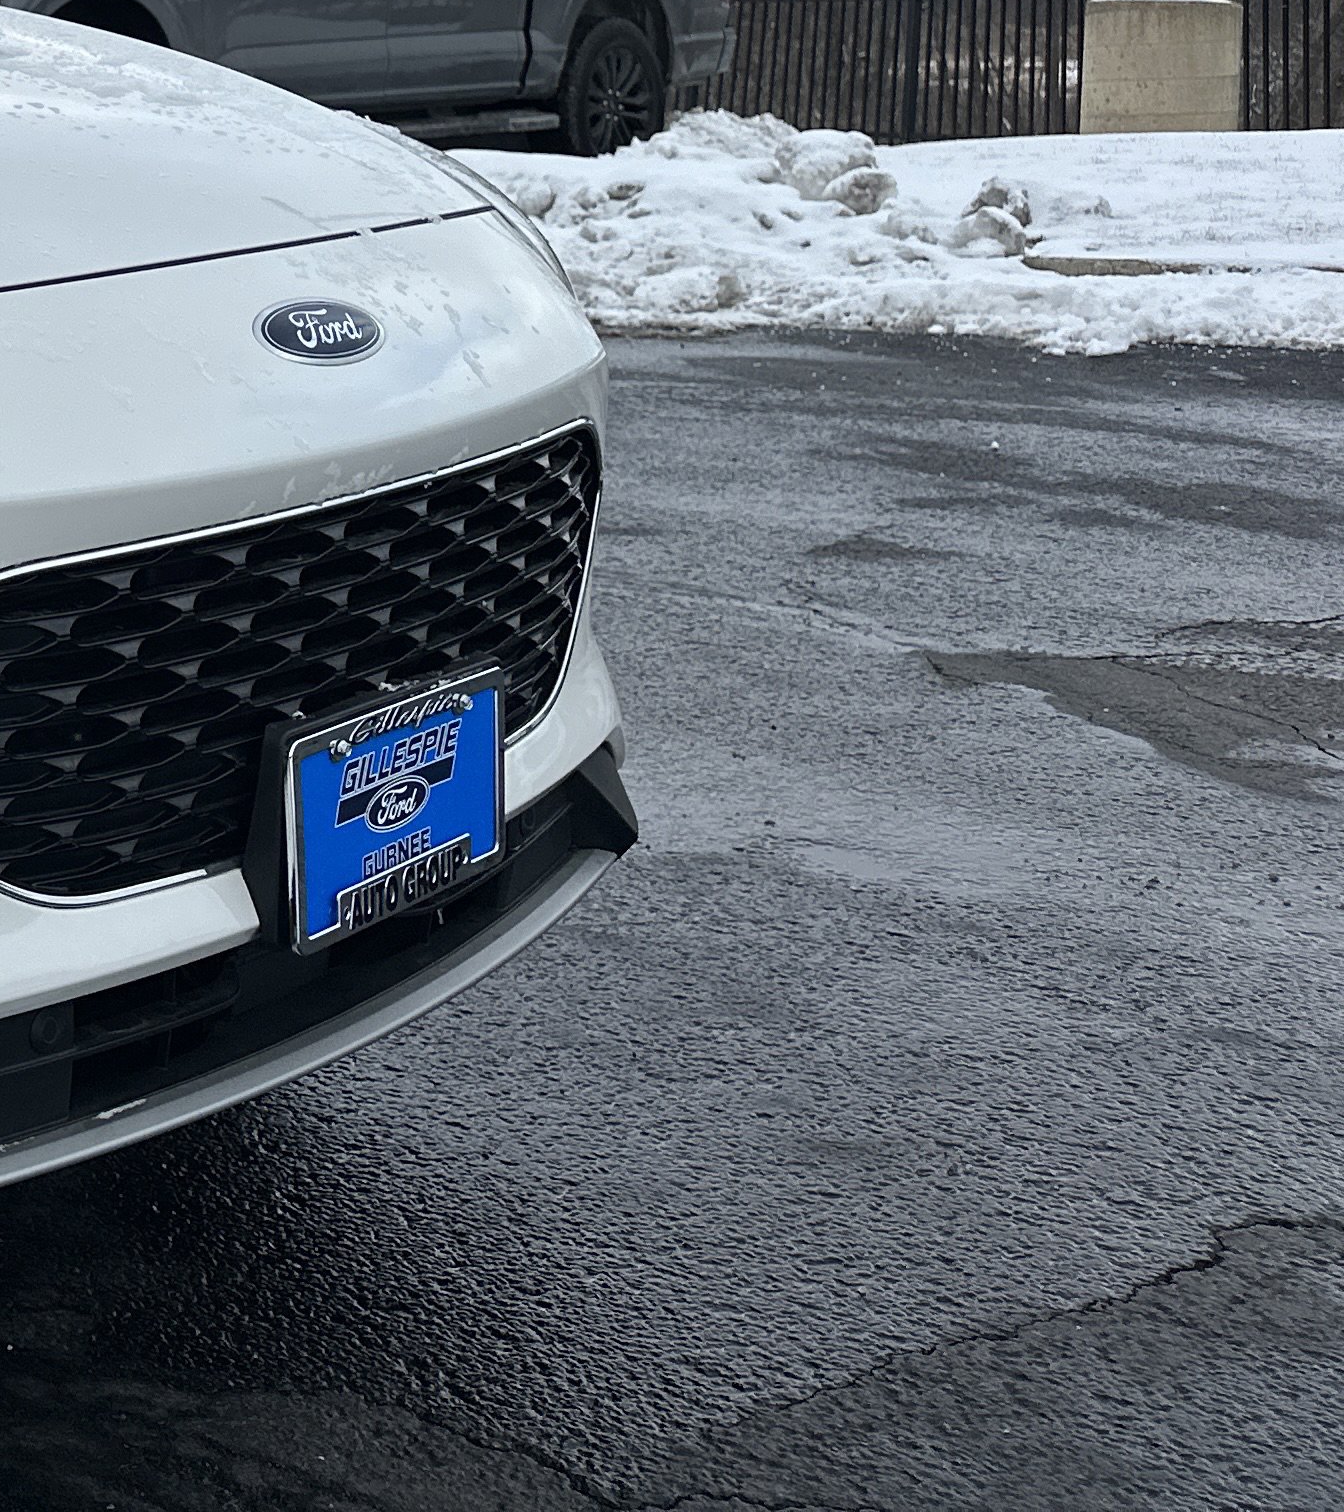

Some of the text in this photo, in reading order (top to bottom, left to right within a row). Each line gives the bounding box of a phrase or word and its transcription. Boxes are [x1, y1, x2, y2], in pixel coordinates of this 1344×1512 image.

[288, 308, 363, 349] Ford
[340, 718, 462, 798] GILLESPIE
[377, 785, 418, 825] Ford
[361, 826, 432, 880] GURNEE
[349, 844, 464, 930] AUTO GROUP
